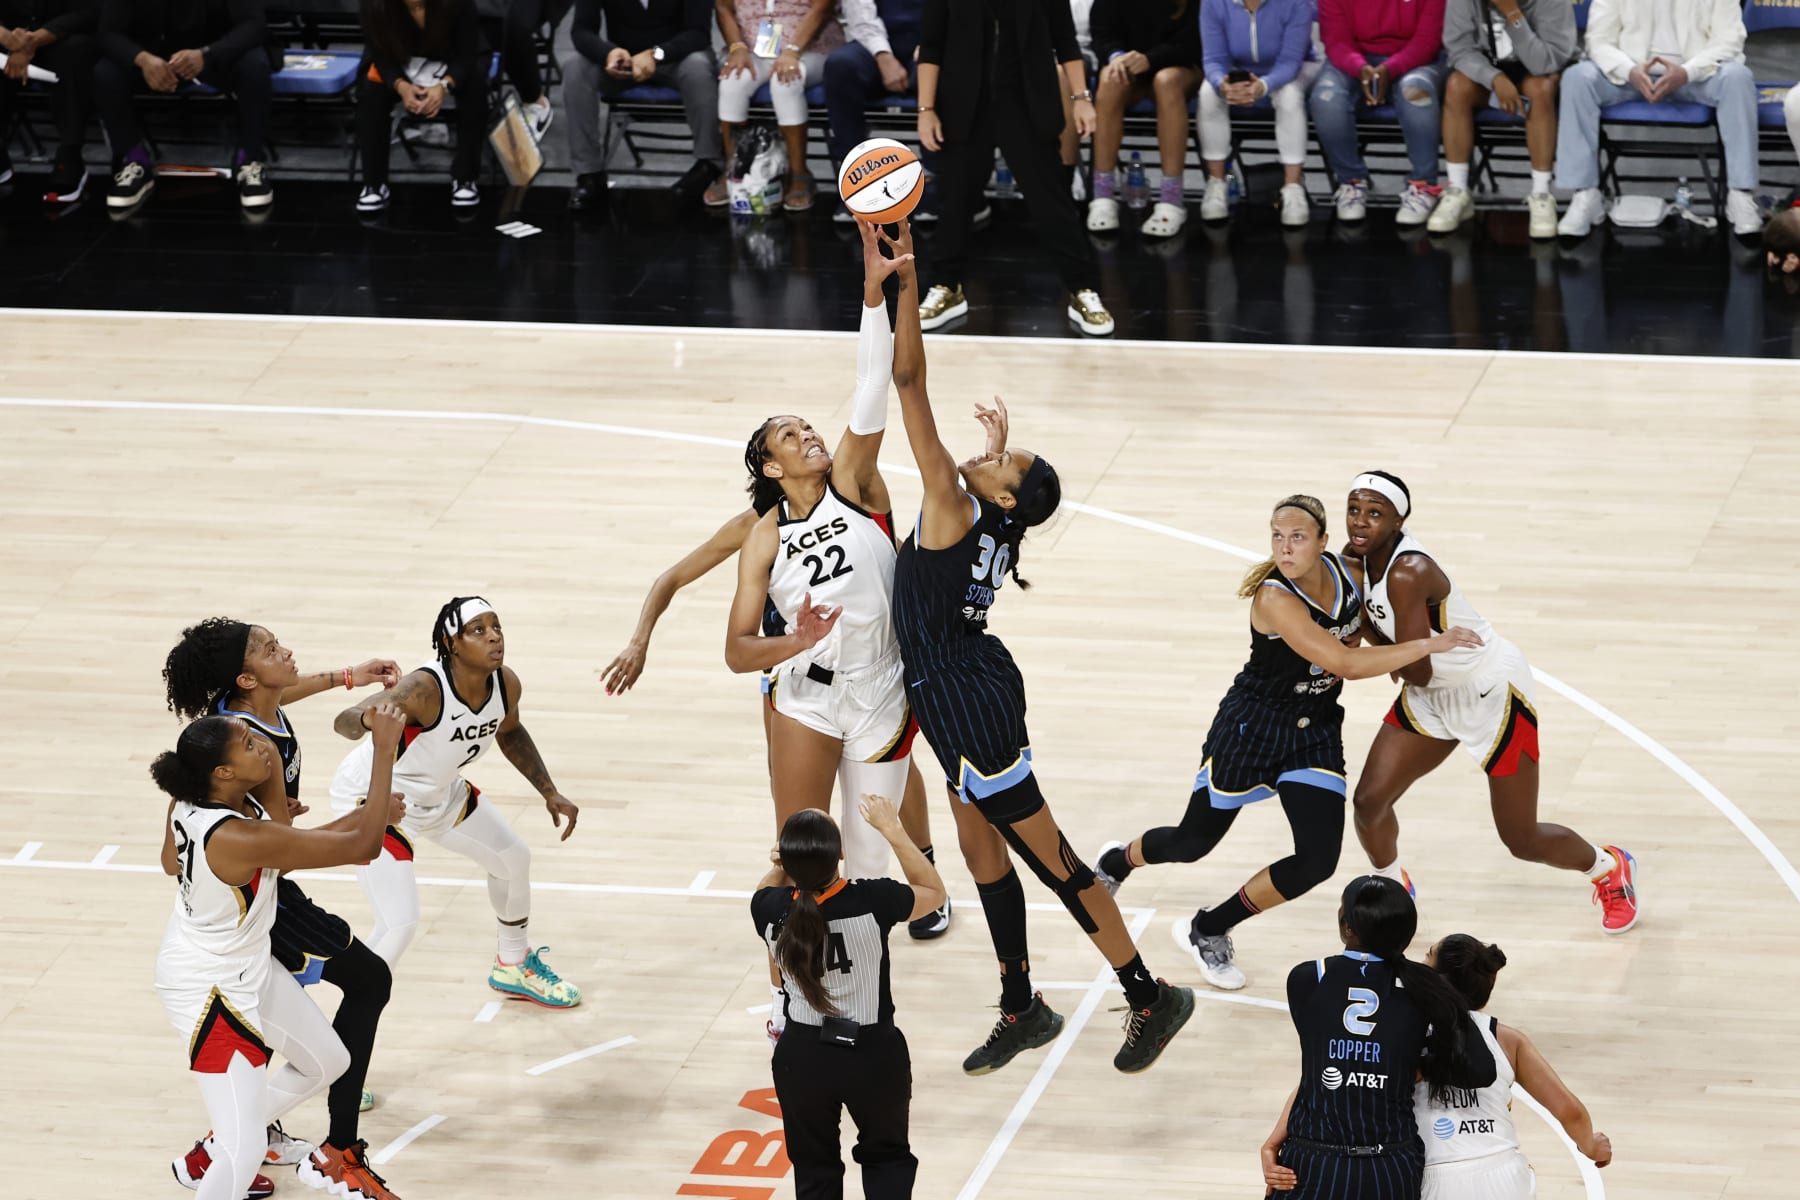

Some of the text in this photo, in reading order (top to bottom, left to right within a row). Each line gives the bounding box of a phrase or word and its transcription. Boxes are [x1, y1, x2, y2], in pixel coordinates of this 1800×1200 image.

[848, 154, 900, 186] Wilson
[787, 516, 849, 560] ACES
[802, 544, 854, 587] 22
[971, 532, 1010, 588] 30
[448, 718, 498, 742] ACES
[457, 743, 480, 769] 2
[820, 932, 853, 976] 4
[1342, 986, 1380, 1036] 2
[1328, 1038, 1381, 1063] COPPER
[1345, 1071, 1389, 1090] AT&T
[1443, 1087, 1480, 1109] PLUM
[1458, 1118, 1495, 1135] AT&T
